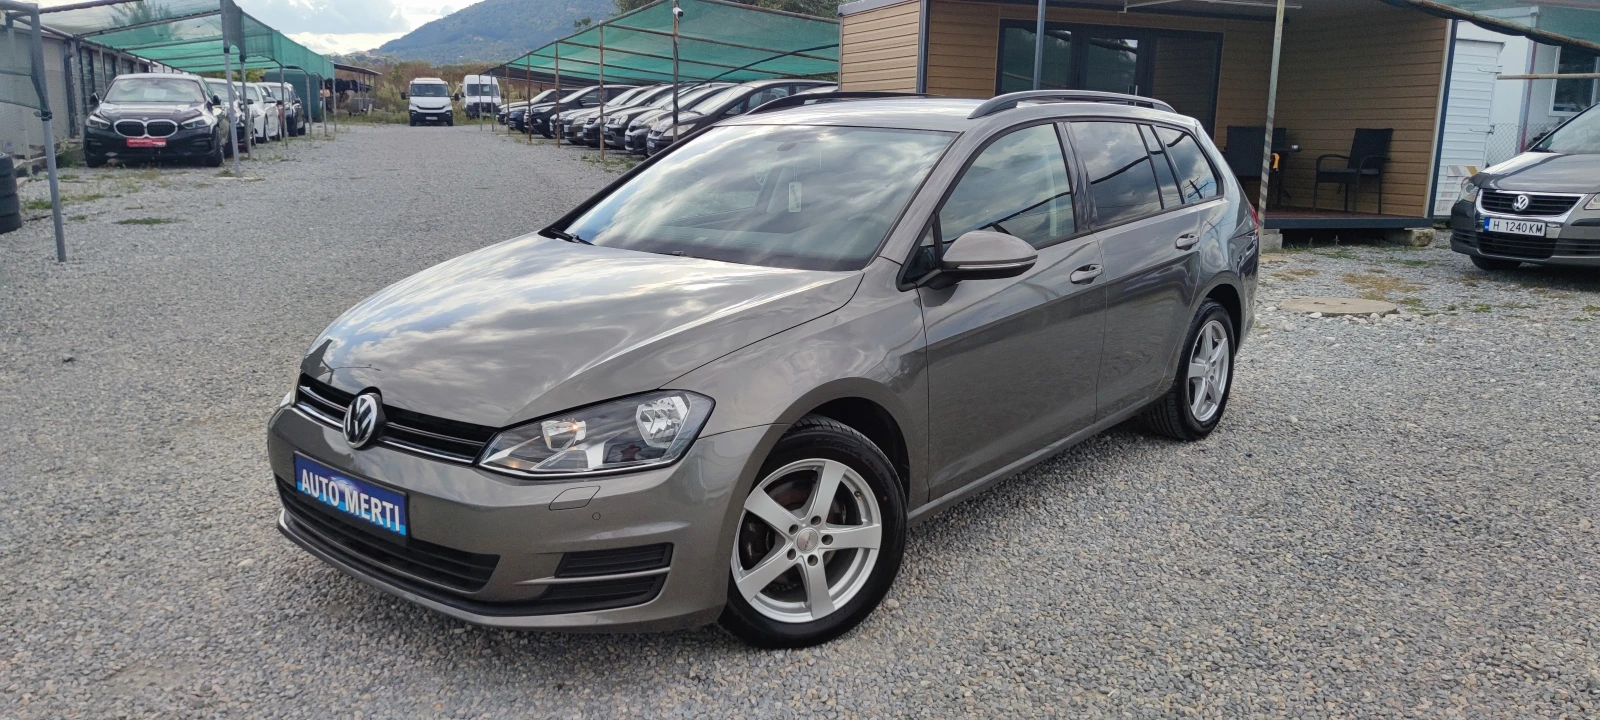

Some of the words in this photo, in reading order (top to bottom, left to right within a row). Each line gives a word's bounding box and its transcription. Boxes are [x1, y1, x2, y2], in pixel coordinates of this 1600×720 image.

[1493, 220, 1500, 231] H
[343, 394, 378, 449] VW
[301, 468, 340, 507] AUTO
[344, 486, 400, 532] MERTI
